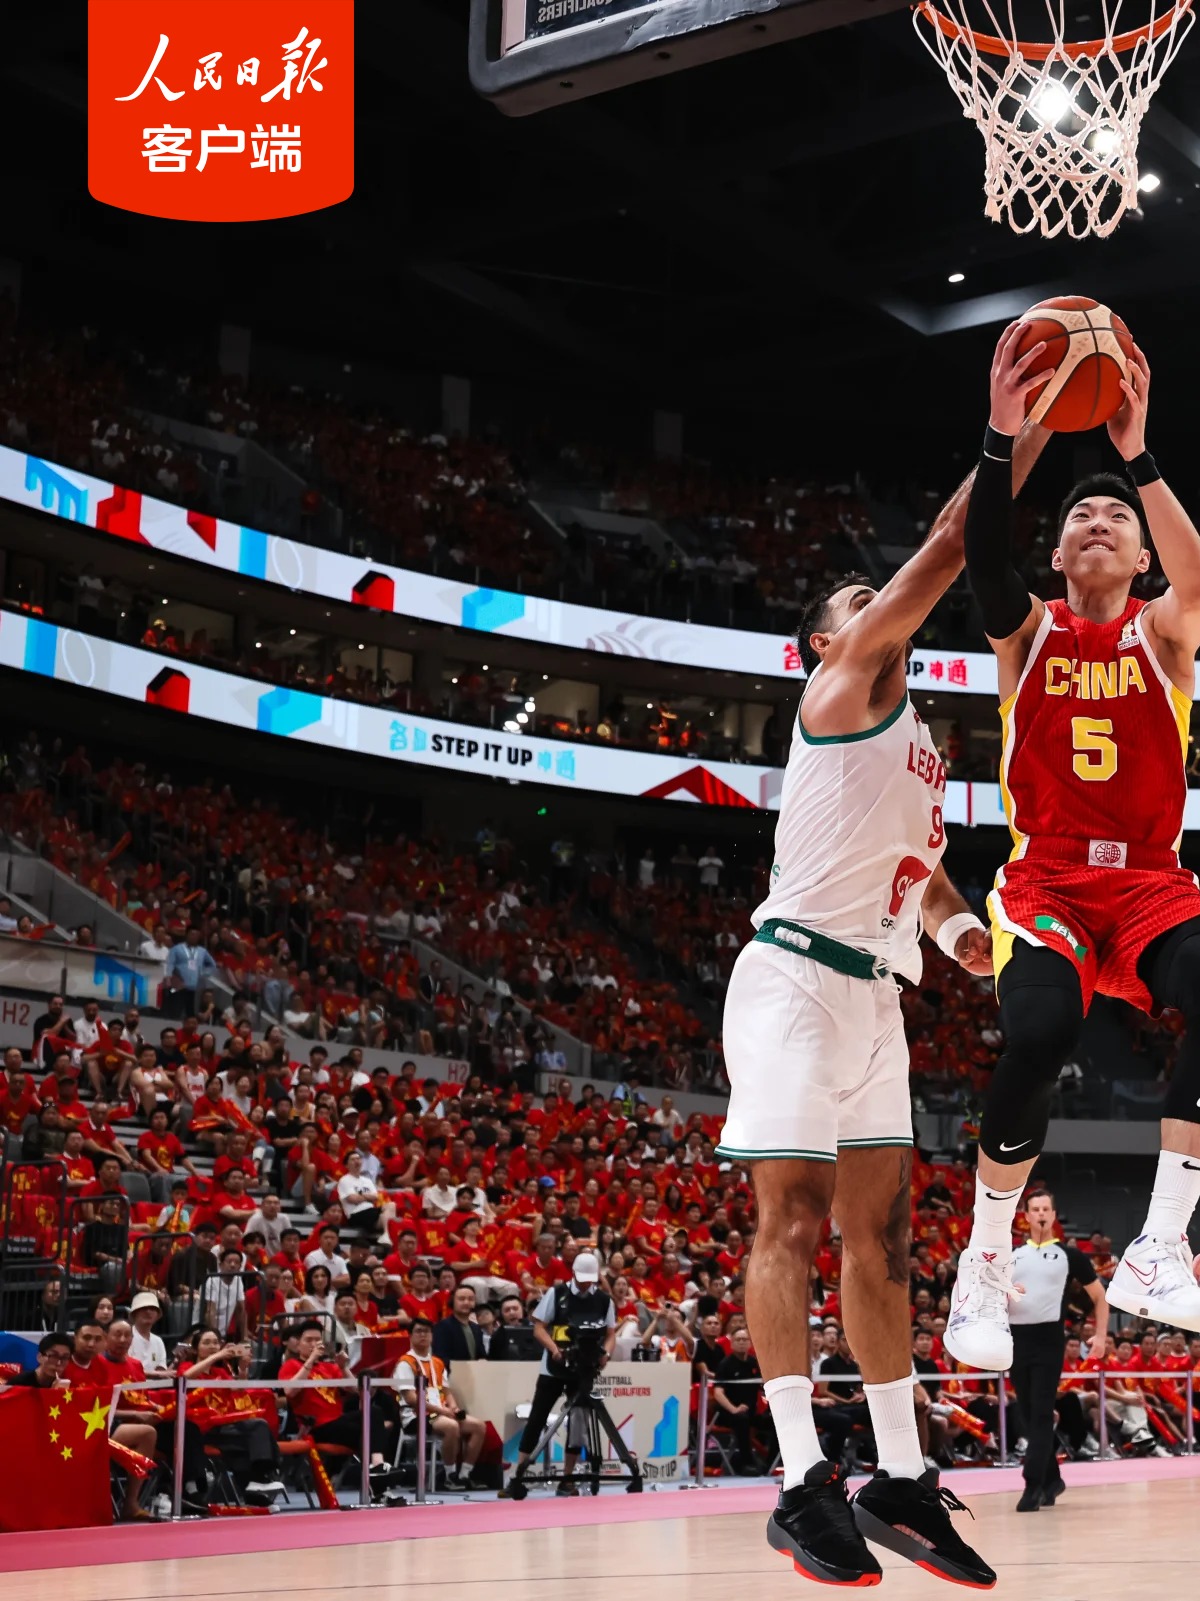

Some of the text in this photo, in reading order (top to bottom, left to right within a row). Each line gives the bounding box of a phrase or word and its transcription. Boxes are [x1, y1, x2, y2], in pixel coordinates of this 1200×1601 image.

[1045, 656, 1147, 700] CHINA
[431, 733, 479, 758] STEP
[483, 742, 503, 762] IT
[507, 746, 533, 767] UP
[1071, 716, 1118, 781] 5
[928, 805, 944, 849] 9
[2, 1001, 31, 1026] H2
[448, 1062, 468, 1082] H2
[612, 1386, 651, 1398] QUALIFIERS
